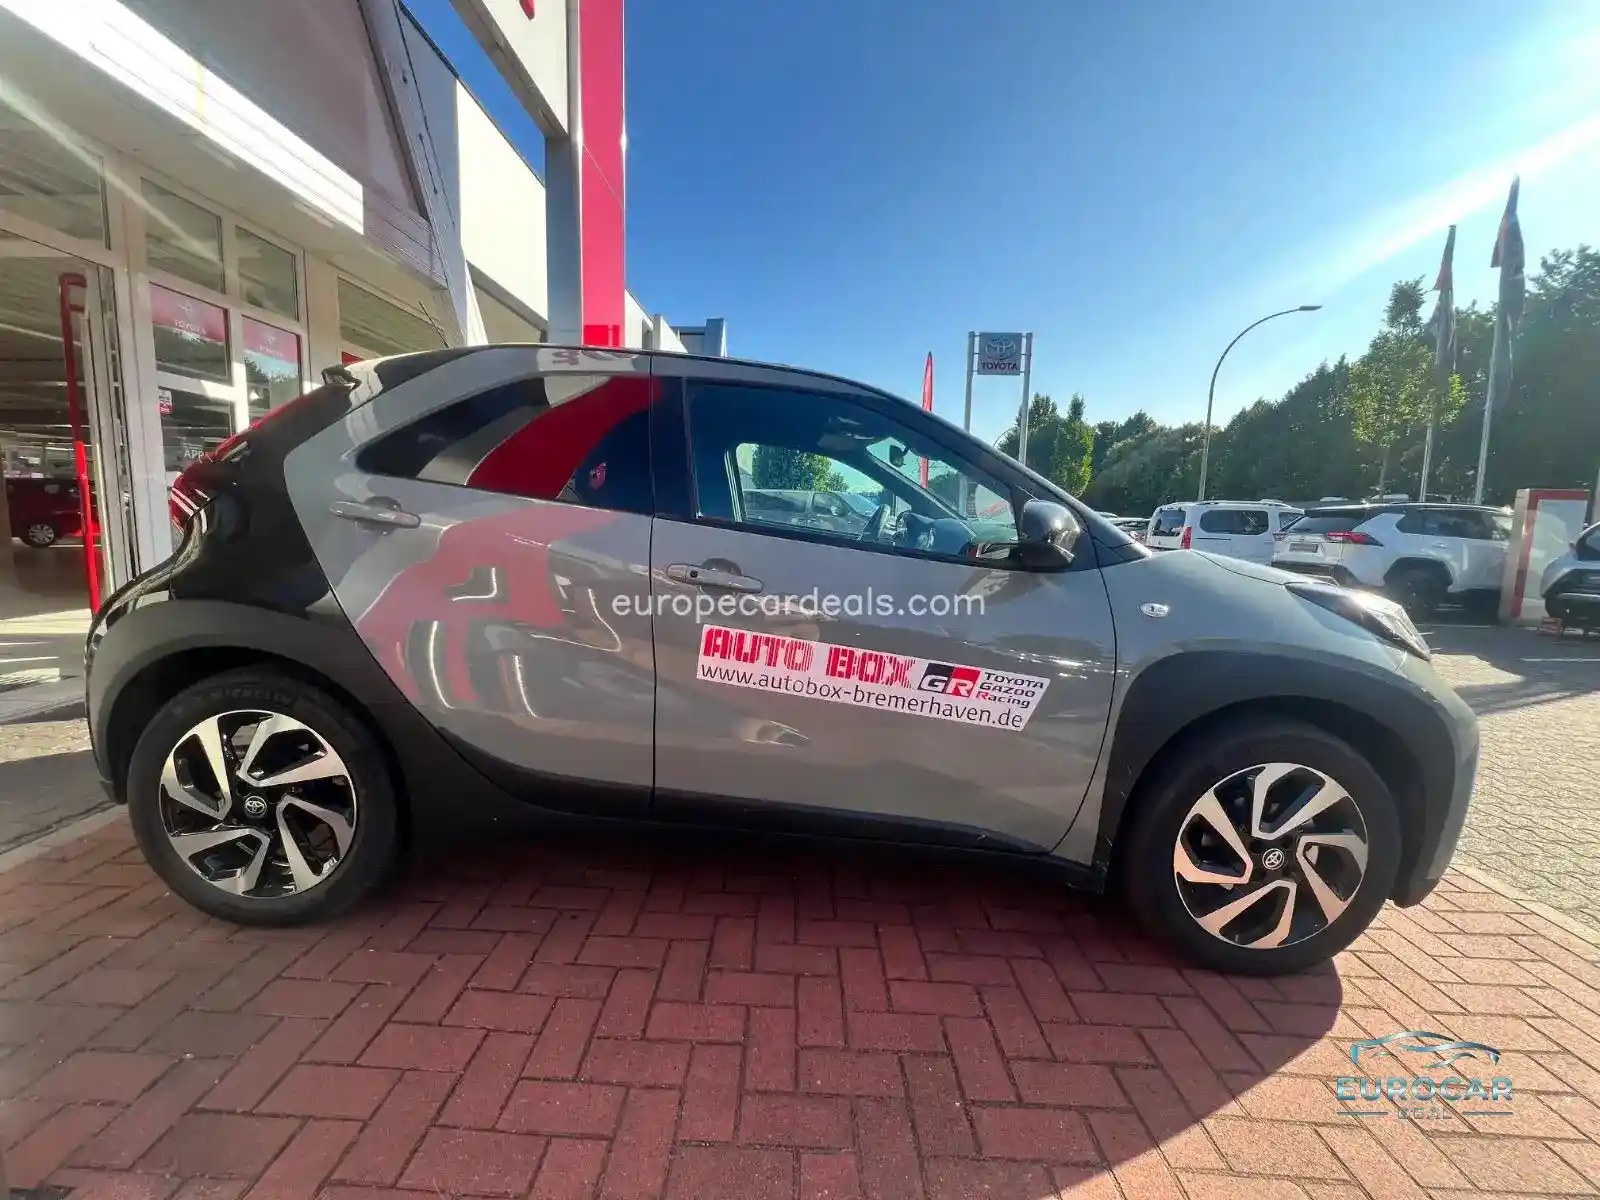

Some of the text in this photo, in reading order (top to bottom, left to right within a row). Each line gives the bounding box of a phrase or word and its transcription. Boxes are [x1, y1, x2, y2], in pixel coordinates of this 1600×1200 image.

[980, 361, 1018, 371] TOYOTA
[703, 627, 916, 689] AUTO BOX
[919, 673, 975, 698] GR
[984, 671, 1044, 689] TOYOTA
[701, 664, 1024, 729] www.autobox-bremerhaven.de
[976, 690, 1030, 709] Racing
[979, 682, 1036, 698] GAZOO
